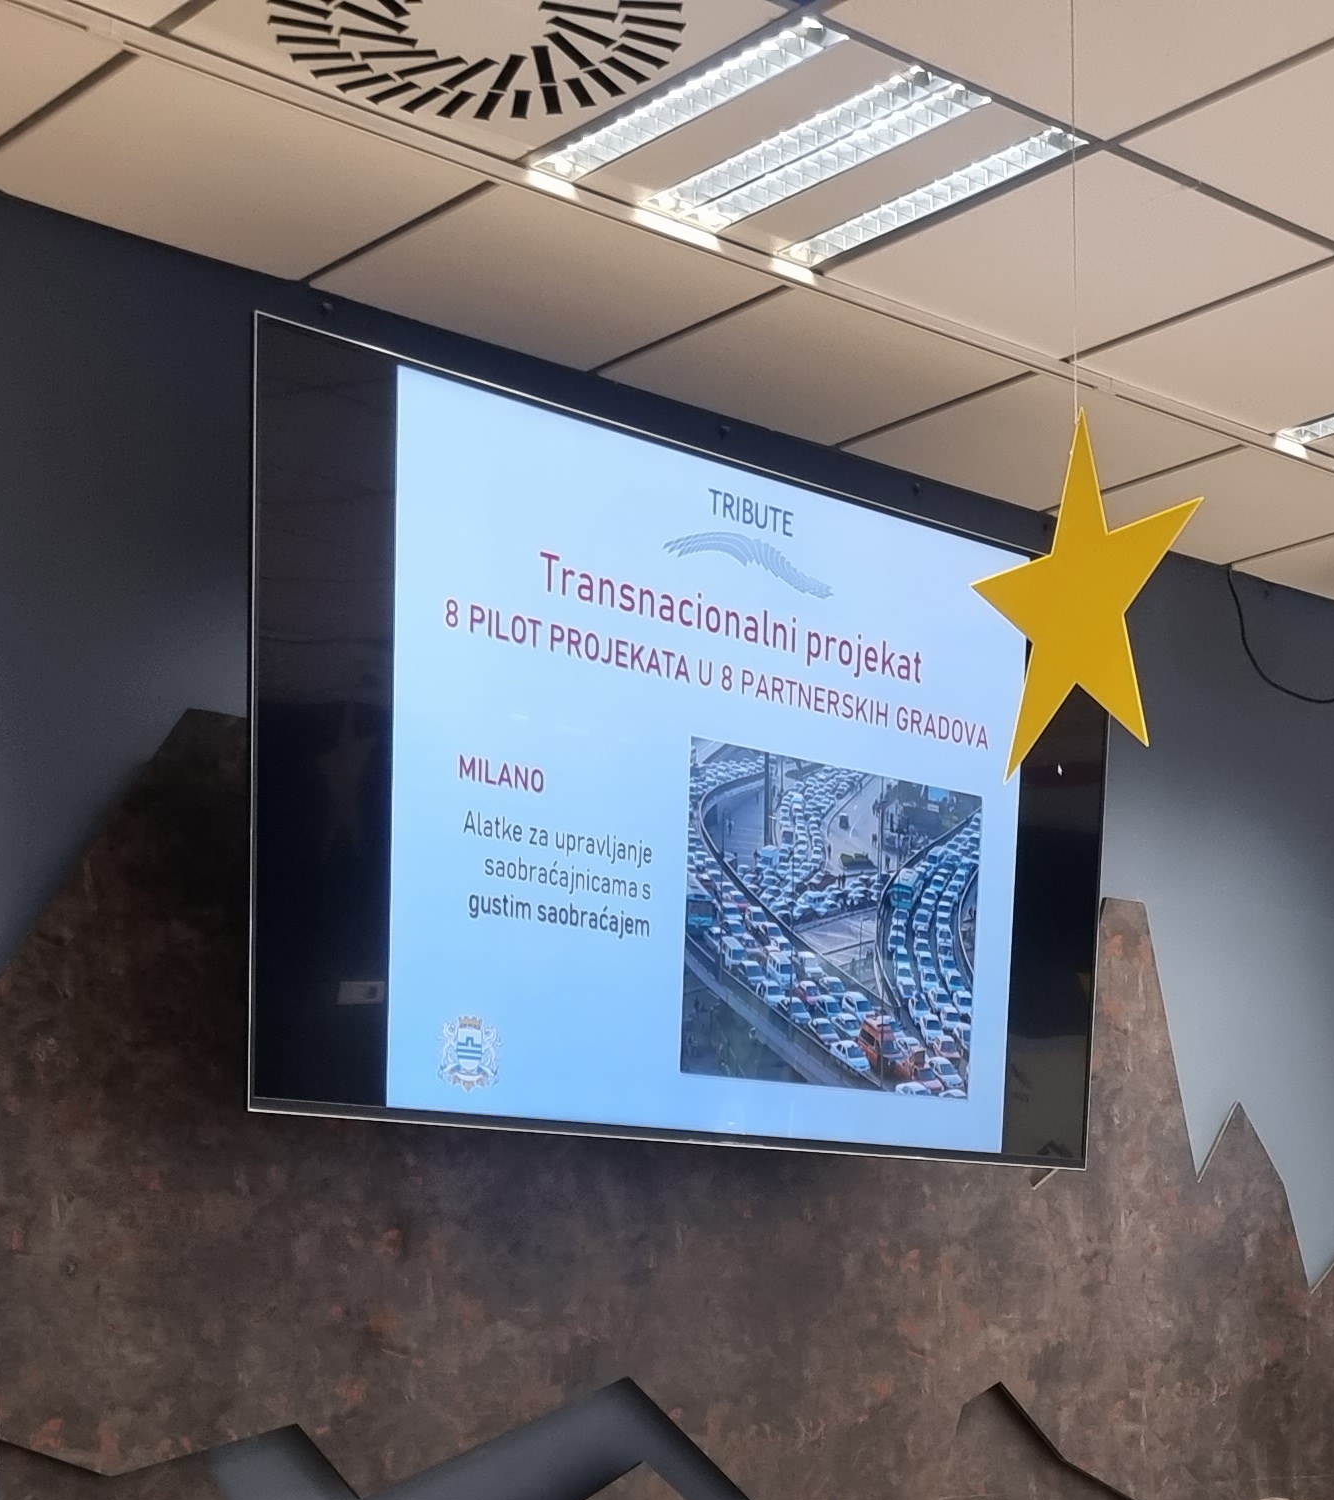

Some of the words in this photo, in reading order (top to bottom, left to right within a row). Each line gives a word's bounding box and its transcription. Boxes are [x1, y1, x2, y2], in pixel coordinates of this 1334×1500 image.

[709, 488, 793, 537] TRIBUTE
[540, 552, 796, 653] Transnacionalni
[807, 631, 921, 683] projekat
[446, 599, 458, 627] 8
[470, 605, 542, 647] PILOT
[550, 624, 690, 683] PROJEKATA
[699, 659, 712, 686] U
[722, 665, 732, 691] 8
[742, 670, 888, 727] PARTNERSKIH
[897, 707, 988, 750] GRADOVA
[459, 755, 543, 793] MILANO
[464, 810, 522, 842] Alatke
[529, 827, 548, 847] za
[556, 832, 652, 868] upravljanje
[485, 857, 637, 898] saobraćajnicama
[642, 884, 650, 900] s
[469, 895, 531, 920] gustim
[537, 903, 649, 939] saobraćajem
